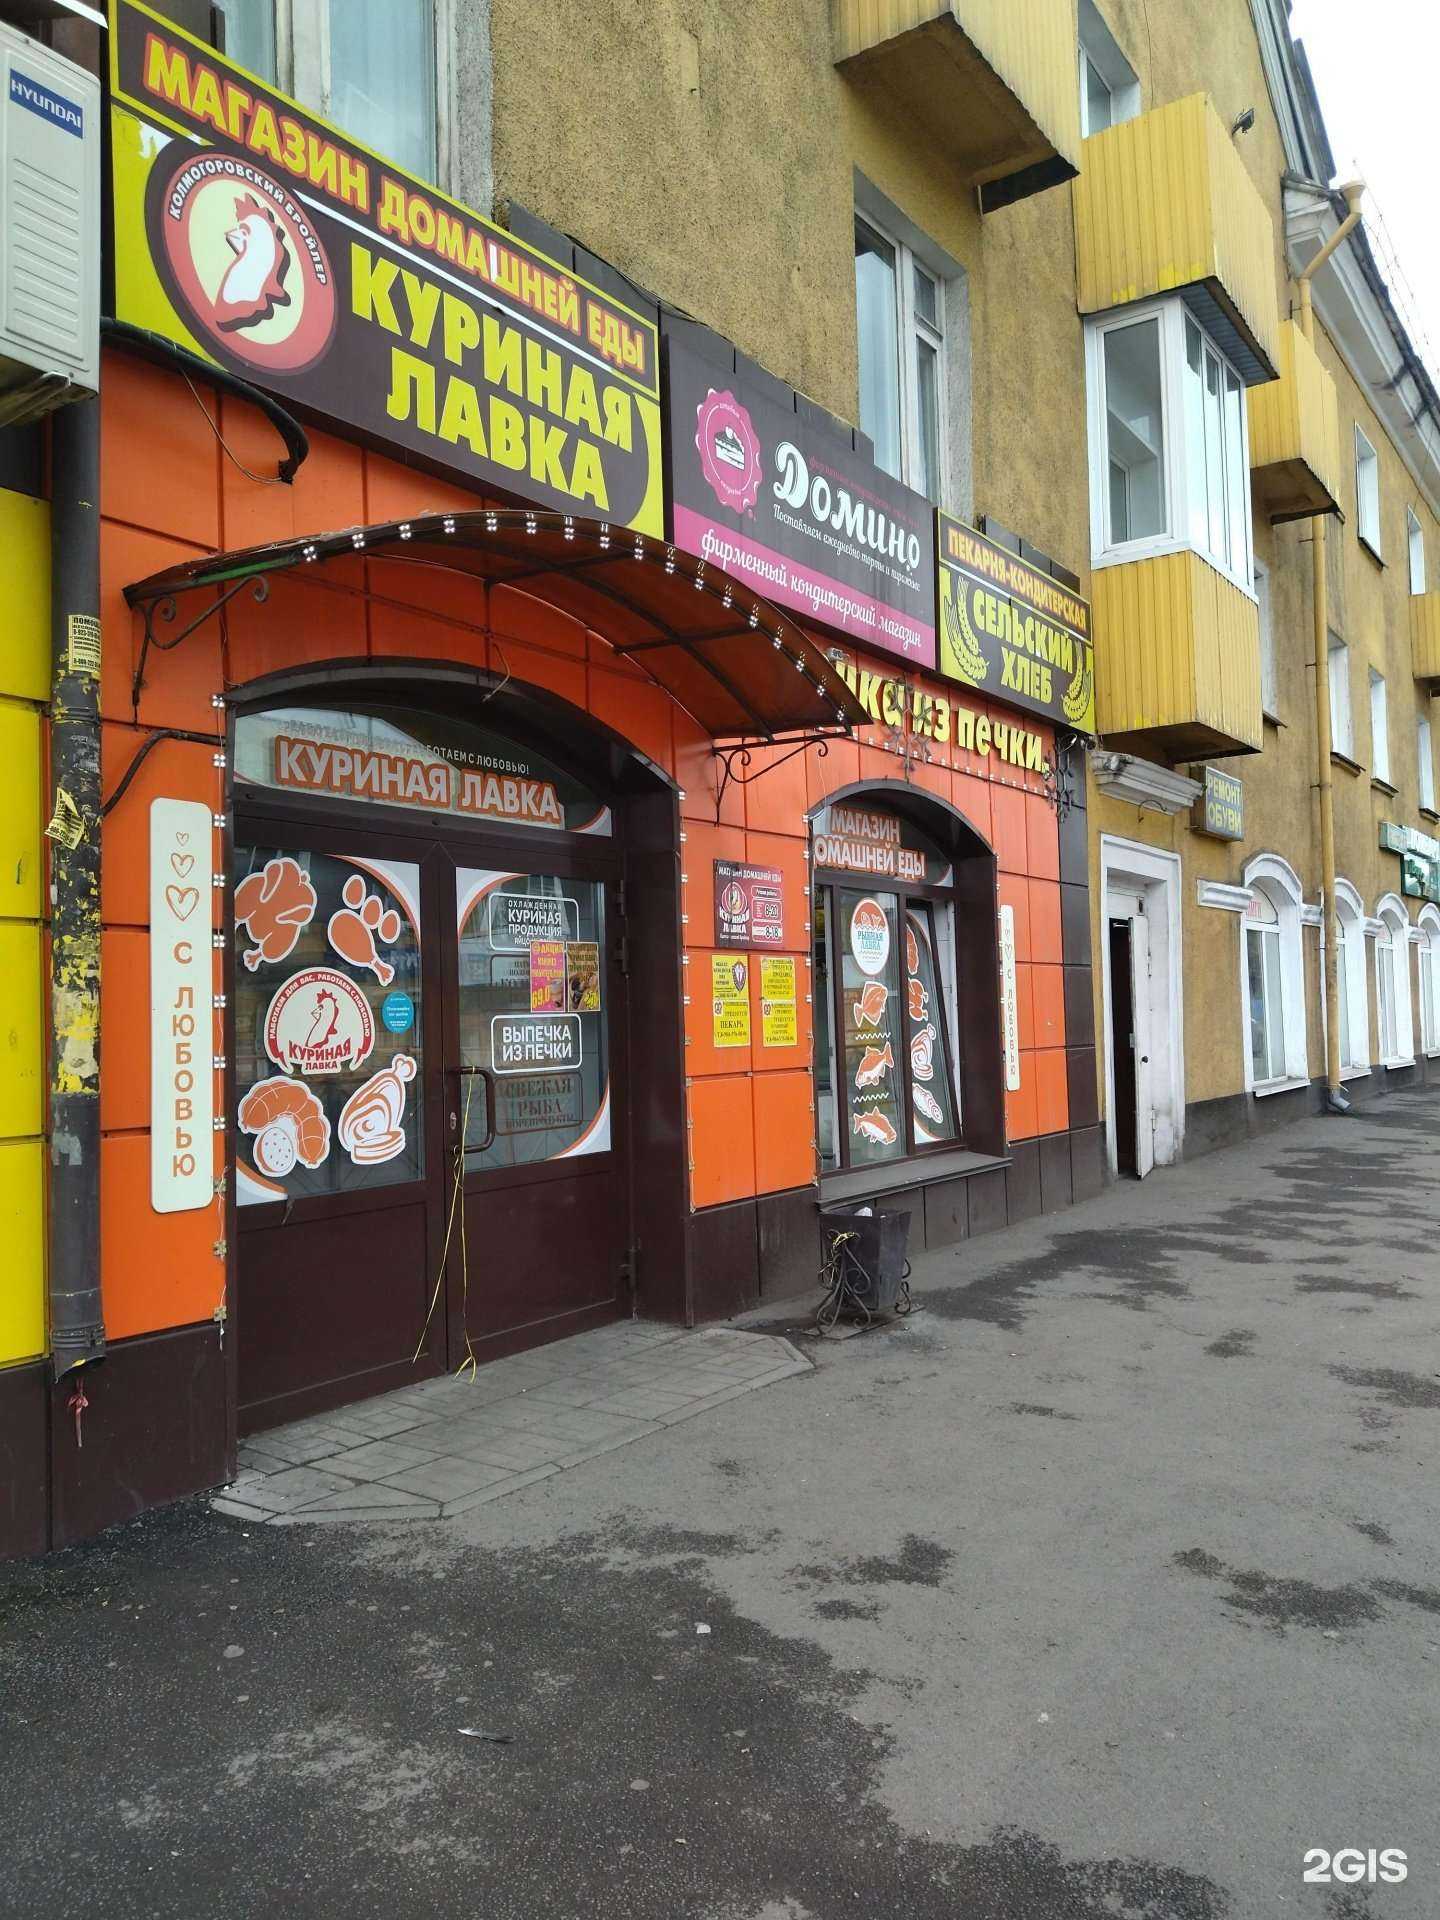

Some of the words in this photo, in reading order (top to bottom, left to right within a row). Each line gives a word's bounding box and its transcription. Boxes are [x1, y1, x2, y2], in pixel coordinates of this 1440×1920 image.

[11, 79, 82, 128] HYUNDAI
[146, 36, 369, 211] МАГАЗИН
[379, 178, 581, 334] ДОМАШНЕЙ
[588, 301, 645, 373] ЕДЫ
[169, 160, 285, 221] КОЛМОГОРОВСКИЙ
[284, 202, 327, 285] БРОЙЛЕР
[351, 242, 636, 452] КУРИНАЯ
[387, 347, 610, 512] ЛАВКА
[773, 441, 921, 570] Домино
[774, 503, 822, 541] Поставляем
[701, 529, 788, 588] фирменный
[790, 573, 876, 626] кондитерский
[878, 611, 922, 650] магазин
[947, 528, 1087, 633] ПЕКАРНЯ-КОНДИТЕРСКАЯ
[973, 588, 1073, 674] СЕЛЬСКИЙ
[1001, 646, 1053, 704] ХЛЕБ
[278, 739, 449, 803] КУРИНАЯ
[461, 772, 562, 820] ЛАВКА
[476, 755, 529, 776] ЛЮБОВЬЮ!
[1206, 773, 1241, 806] РЕМОНТ
[831, 809, 901, 843] МАГАЗИН
[1208, 802, 1242, 833] ОБУВИ
[898, 850, 925, 878] ЕДЫ
[508, 908, 562, 925] КУРИНАЯ
[508, 923, 562, 938] ПРОДУКЦИЯ
[173, 942, 193, 965] С
[317, 973, 353, 995] РАБОТАЕМ
[288, 1037, 351, 1061] КУРИНАЯ
[502, 1024, 572, 1043] ВЫПЕЧКА
[305, 1060, 338, 1070] ЛАВКА
[502, 1044, 522, 1062] ИЗ
[525, 1042, 573, 1061] ПЕЧКИ
[171, 986, 196, 1178] ЛЮБОВЬЮ
